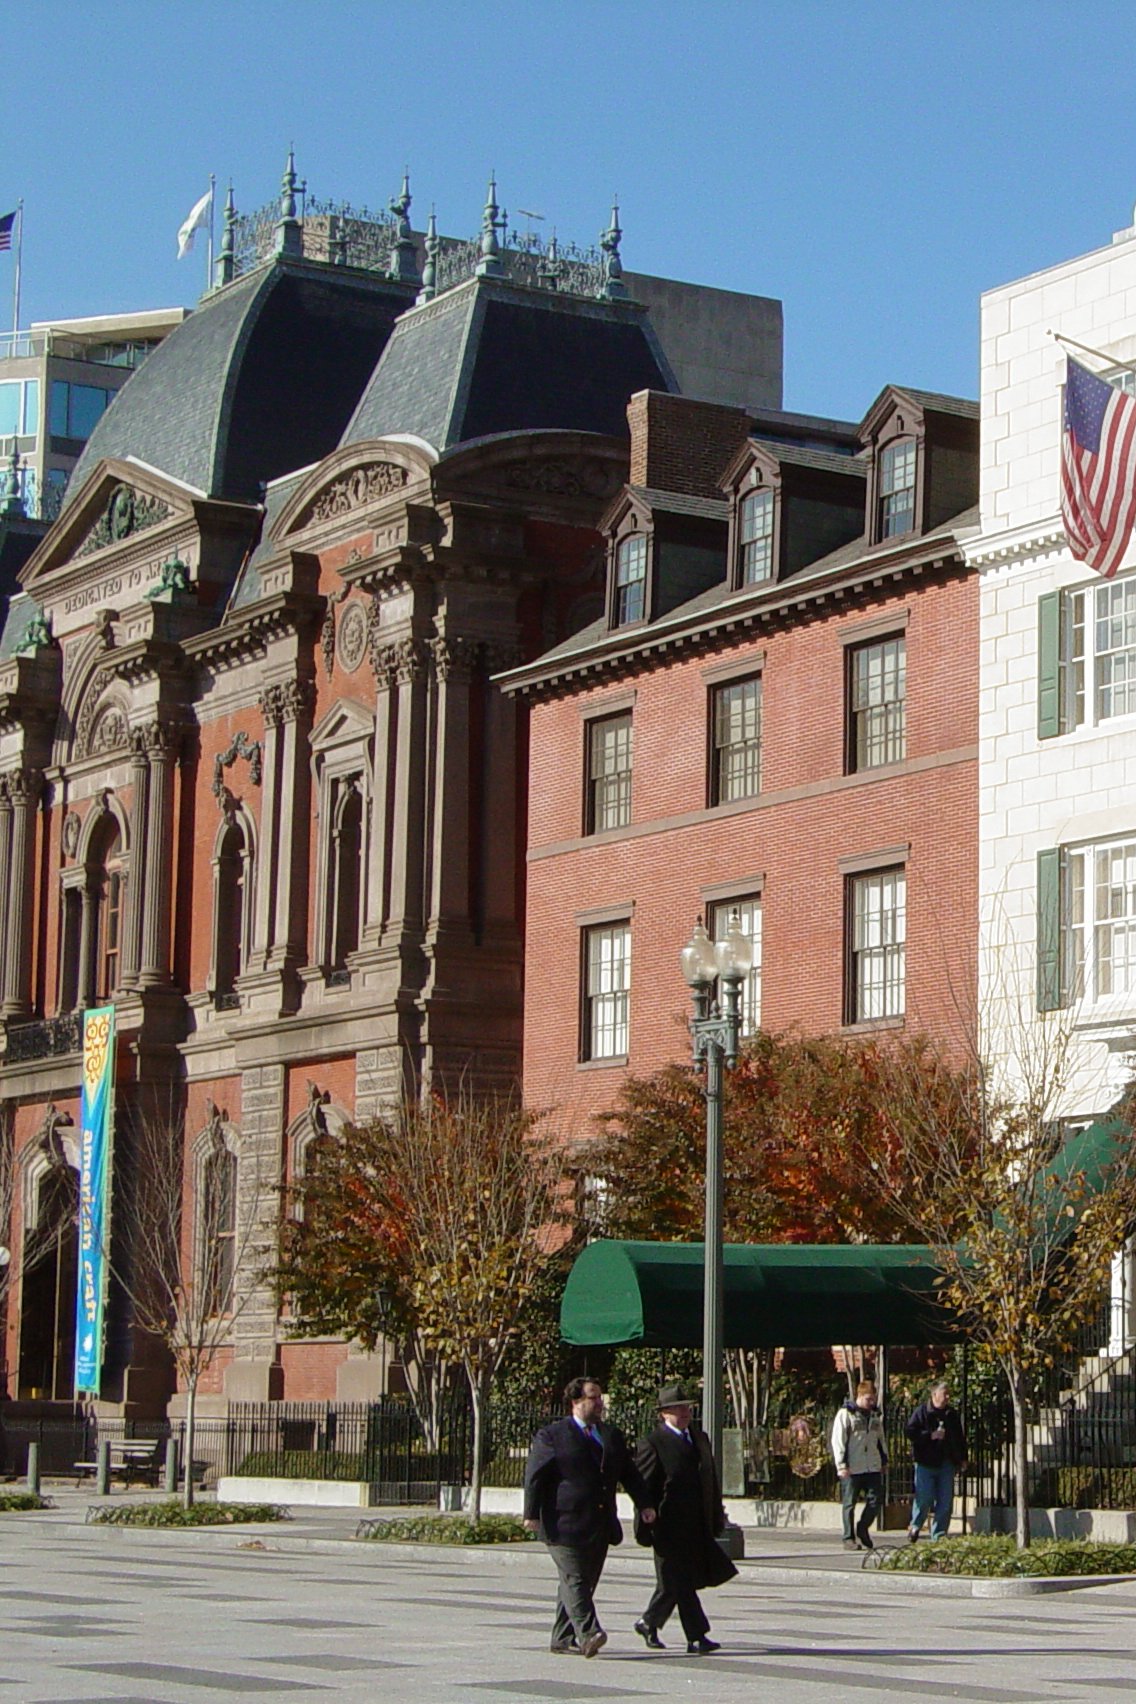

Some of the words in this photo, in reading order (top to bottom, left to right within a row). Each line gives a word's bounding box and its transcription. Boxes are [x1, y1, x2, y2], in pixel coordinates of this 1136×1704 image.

[64, 580, 122, 615] DEDICATED
[128, 568, 141, 588] TO
[82, 1129, 95, 1250] american
[84, 1260, 97, 1323] craft
